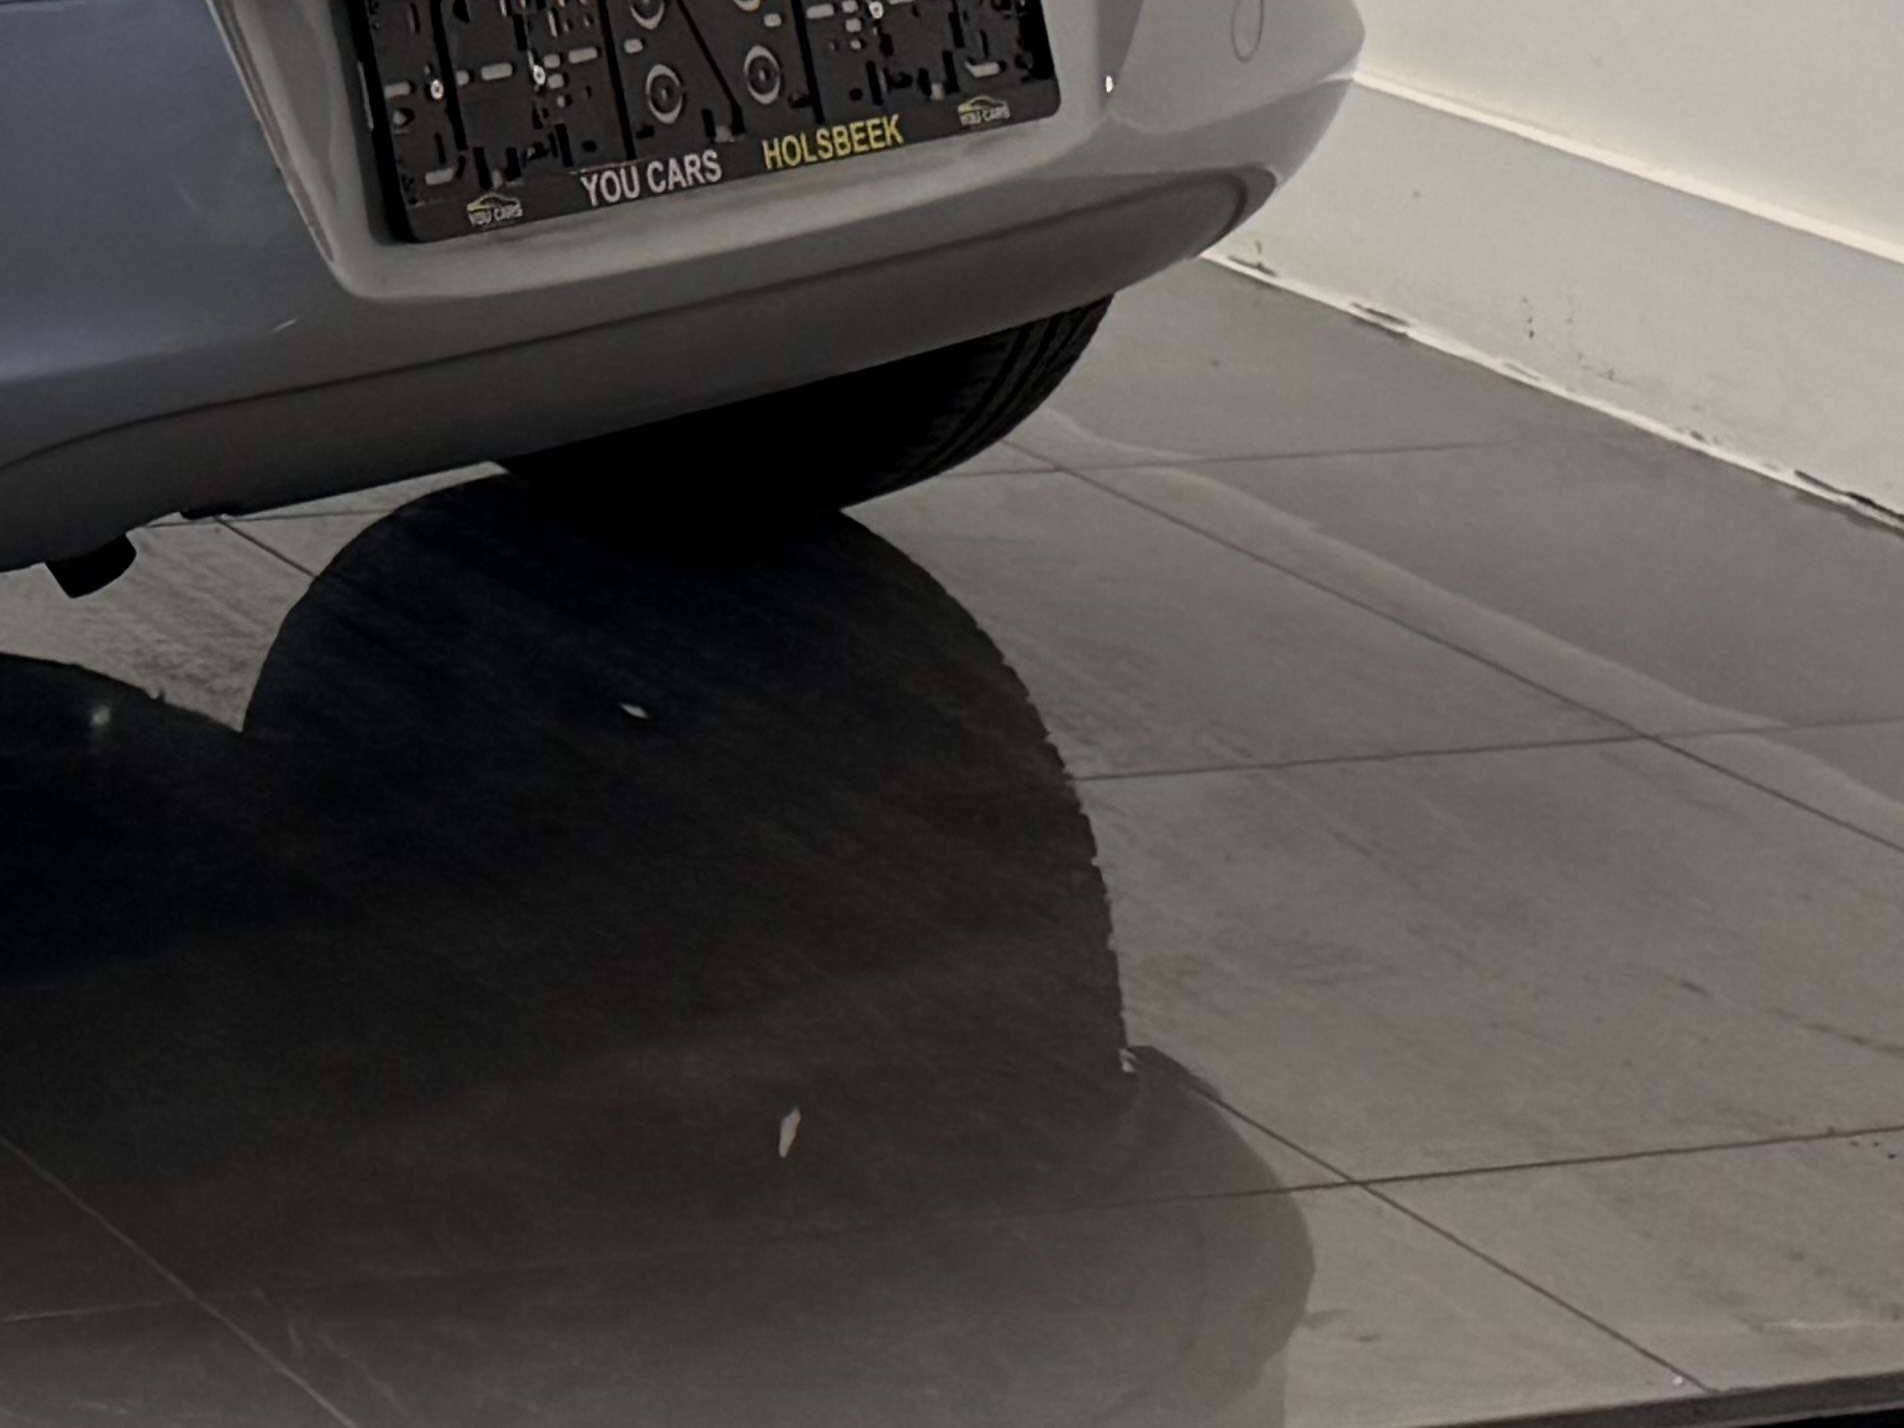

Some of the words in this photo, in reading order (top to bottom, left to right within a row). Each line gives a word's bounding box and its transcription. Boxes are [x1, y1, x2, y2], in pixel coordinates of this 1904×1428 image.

[580, 165, 641, 208] YOU
[646, 149, 723, 194] CARS
[761, 113, 905, 171] HOLSBEEK
